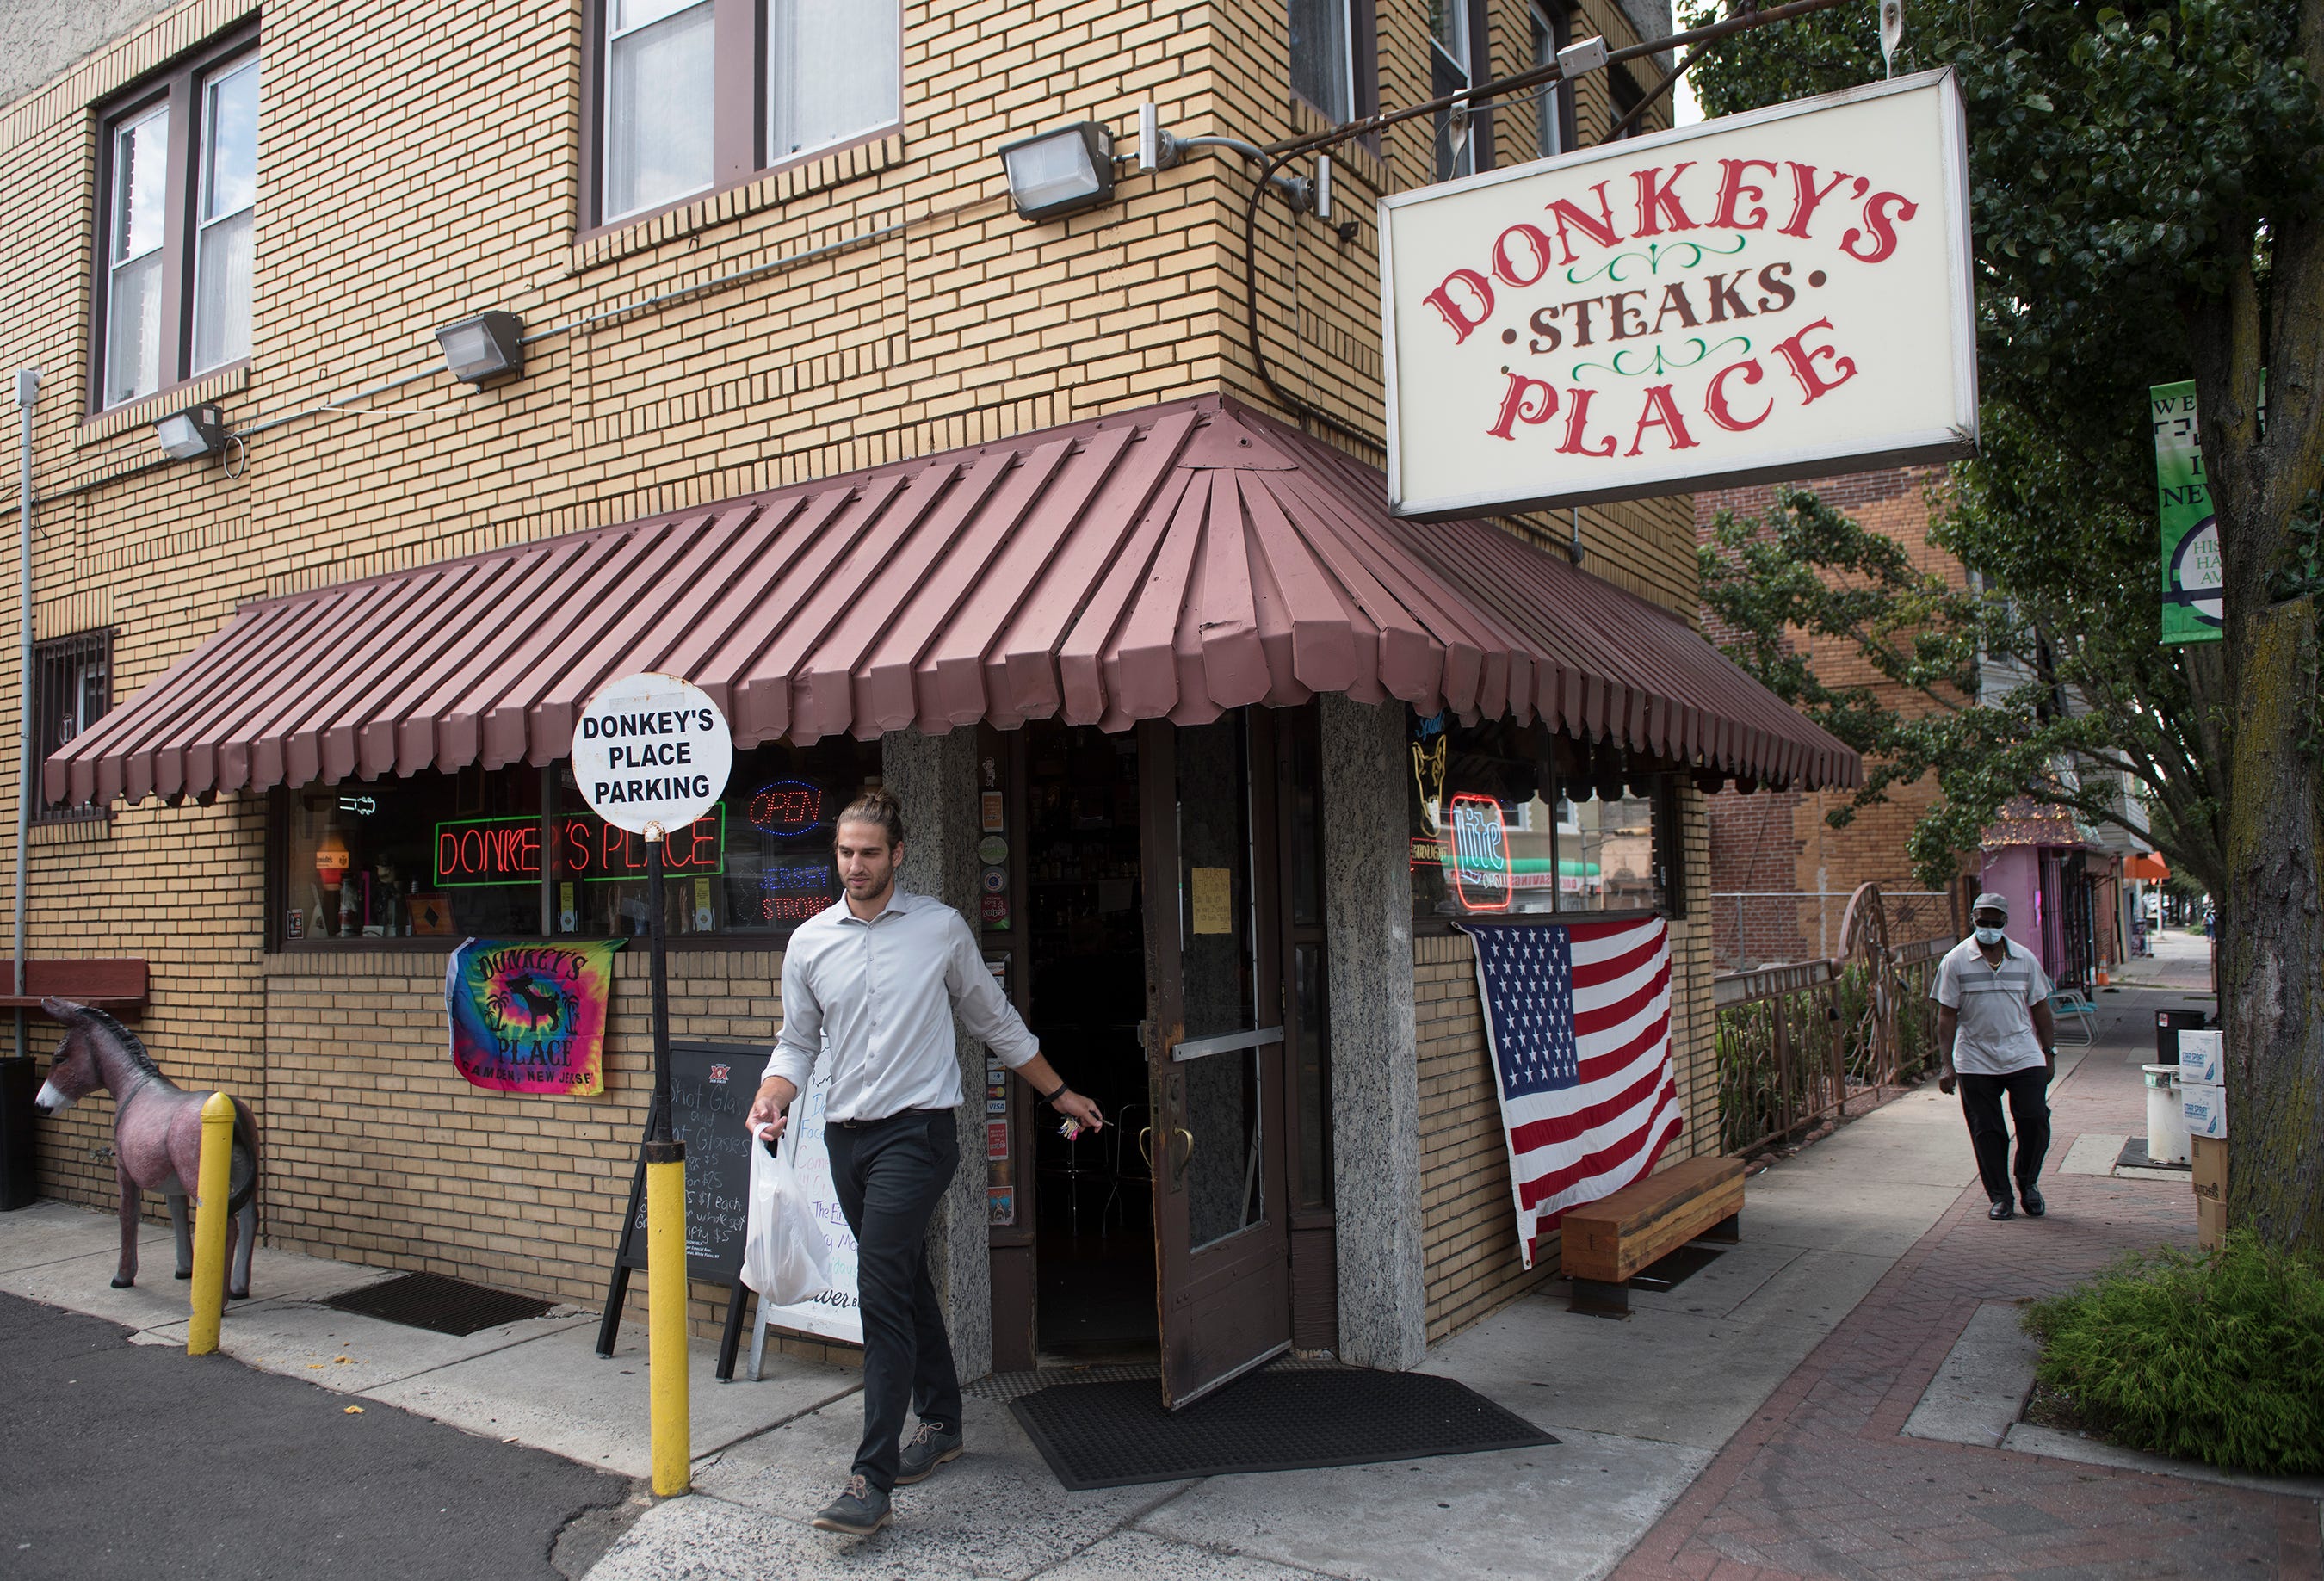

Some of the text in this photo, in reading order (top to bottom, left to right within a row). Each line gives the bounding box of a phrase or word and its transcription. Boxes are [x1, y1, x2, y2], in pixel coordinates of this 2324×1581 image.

[1422, 158, 1919, 344] DONKEY'S
[1529, 262, 1796, 355] STEAKS
[1486, 316, 1858, 458] PLACE
[2162, 483, 2210, 508] NE
[583, 708, 714, 738] DONKEY'S
[609, 742, 691, 769] PLACE
[595, 775, 710, 805] PARKING
[750, 790, 822, 824] OPEN
[440, 818, 716, 875] DONKE'S PLCE
[759, 866, 829, 890] JERSEY
[477, 948, 588, 981] DONKEY'S
[497, 1036, 572, 1067] PLACE
[528, 1071, 555, 1082] NEW
[559, 1072, 594, 1084] JERSE
[690, 1110, 714, 1127] and
[705, 1153, 719, 1165] $5
[812, 1200, 829, 1219] The
